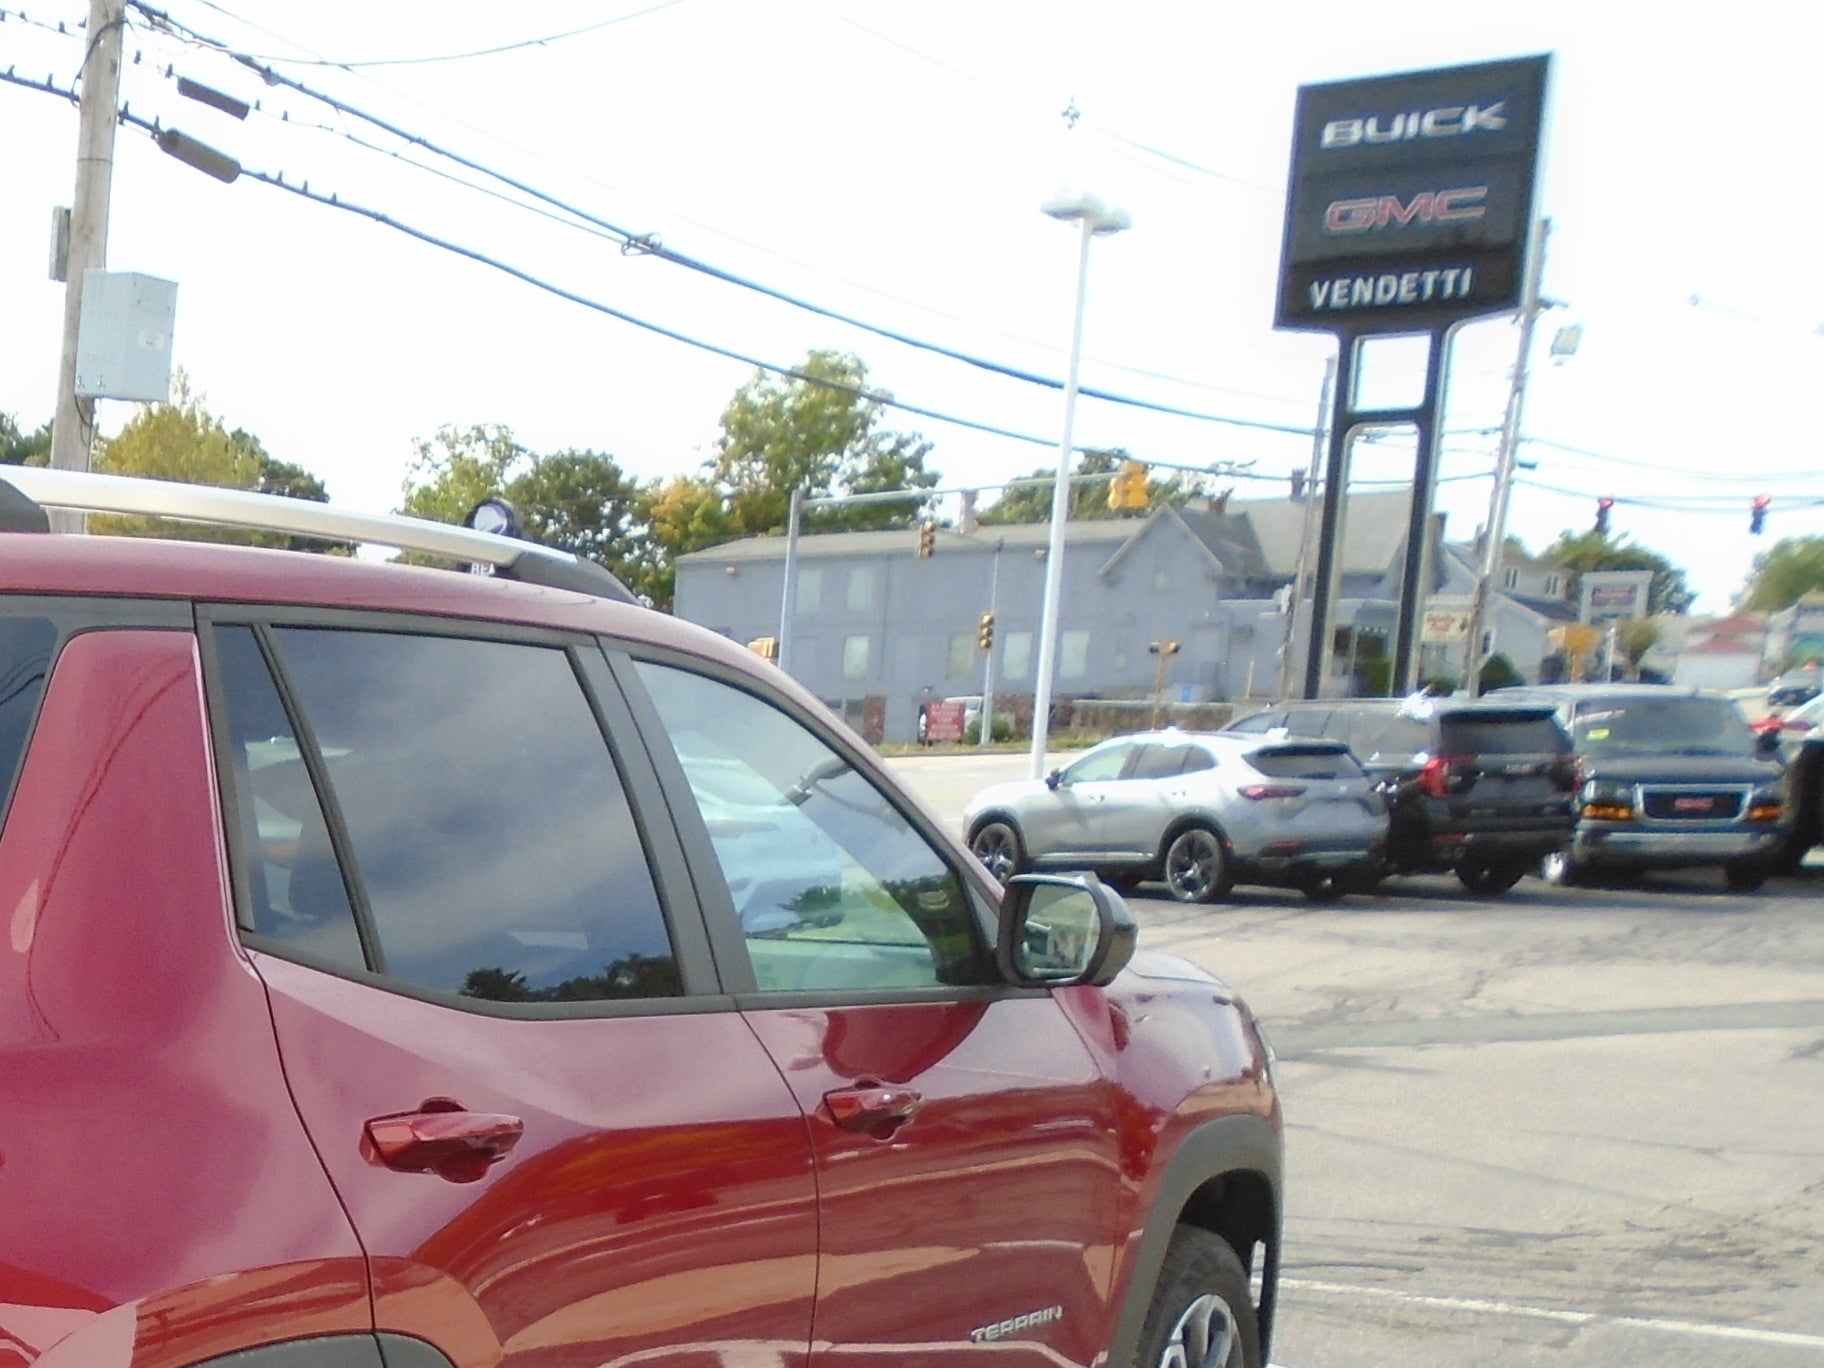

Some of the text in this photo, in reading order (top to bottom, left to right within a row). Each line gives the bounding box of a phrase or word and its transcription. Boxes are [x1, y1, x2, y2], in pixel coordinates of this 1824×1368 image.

[1321, 101, 1508, 149] BUICK
[1323, 186, 1488, 232] GMC
[1309, 264, 1473, 311] VENDETTI
[970, 1304, 1064, 1343] TERRAIN
